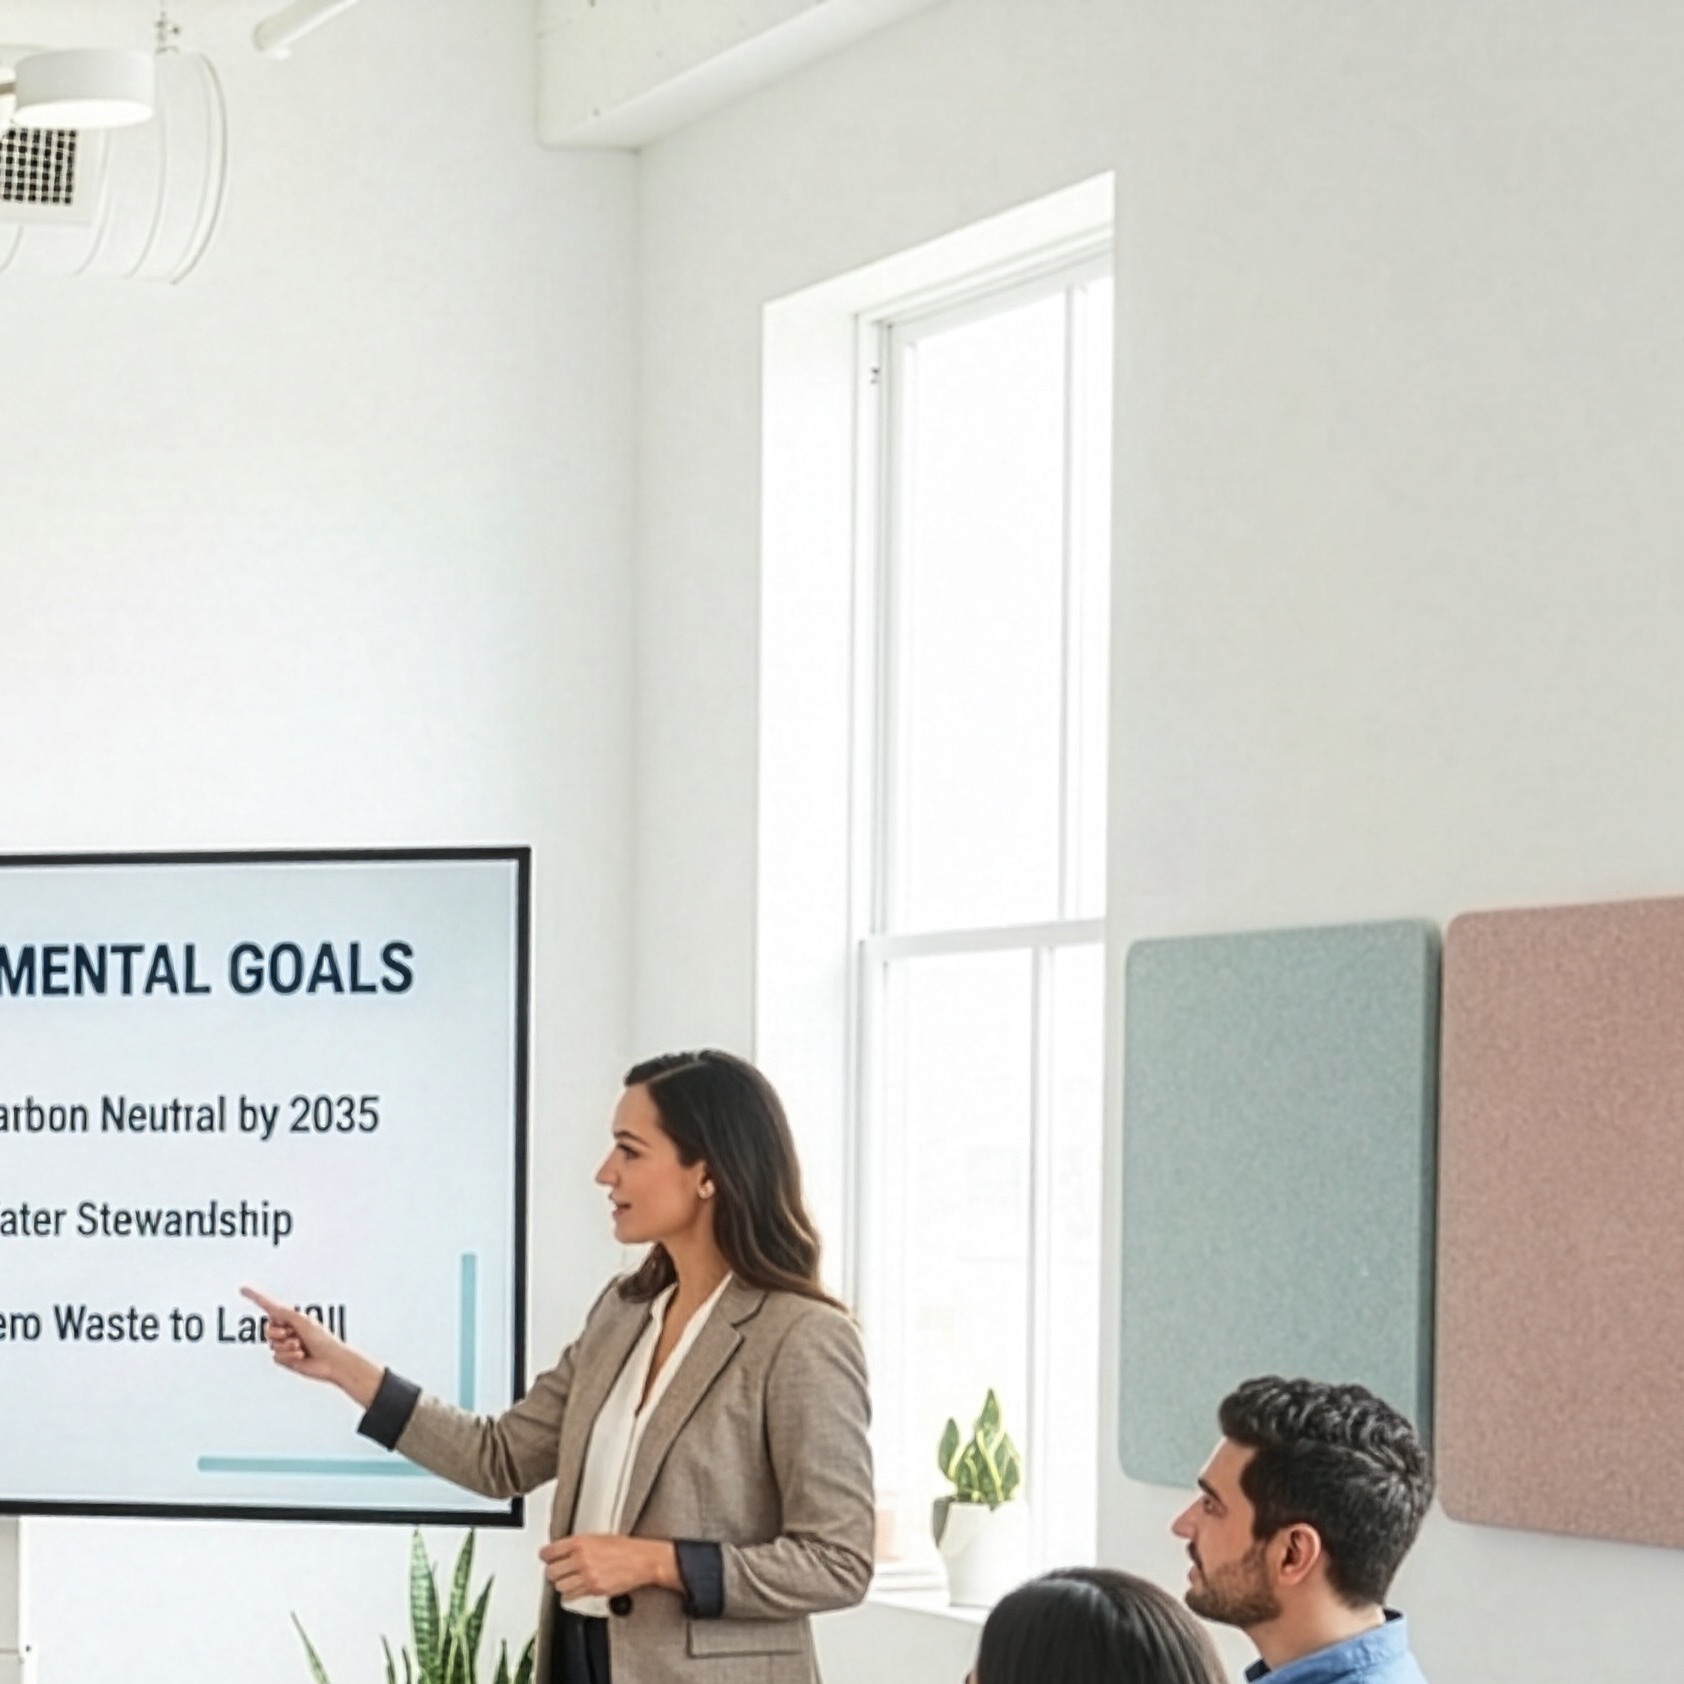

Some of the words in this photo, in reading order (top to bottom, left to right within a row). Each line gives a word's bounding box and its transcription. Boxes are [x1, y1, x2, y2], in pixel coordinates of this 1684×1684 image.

[229, 941, 414, 995] GOALS
[101, 1095, 226, 1133] Neutral
[239, 1095, 280, 1142] by
[289, 1095, 379, 1133] 2035
[77, 1200, 293, 1246] Stewardship
[53, 1304, 160, 1342] Waste
[169, 1308, 204, 1343] to
[217, 1303, 347, 1344] Lall
